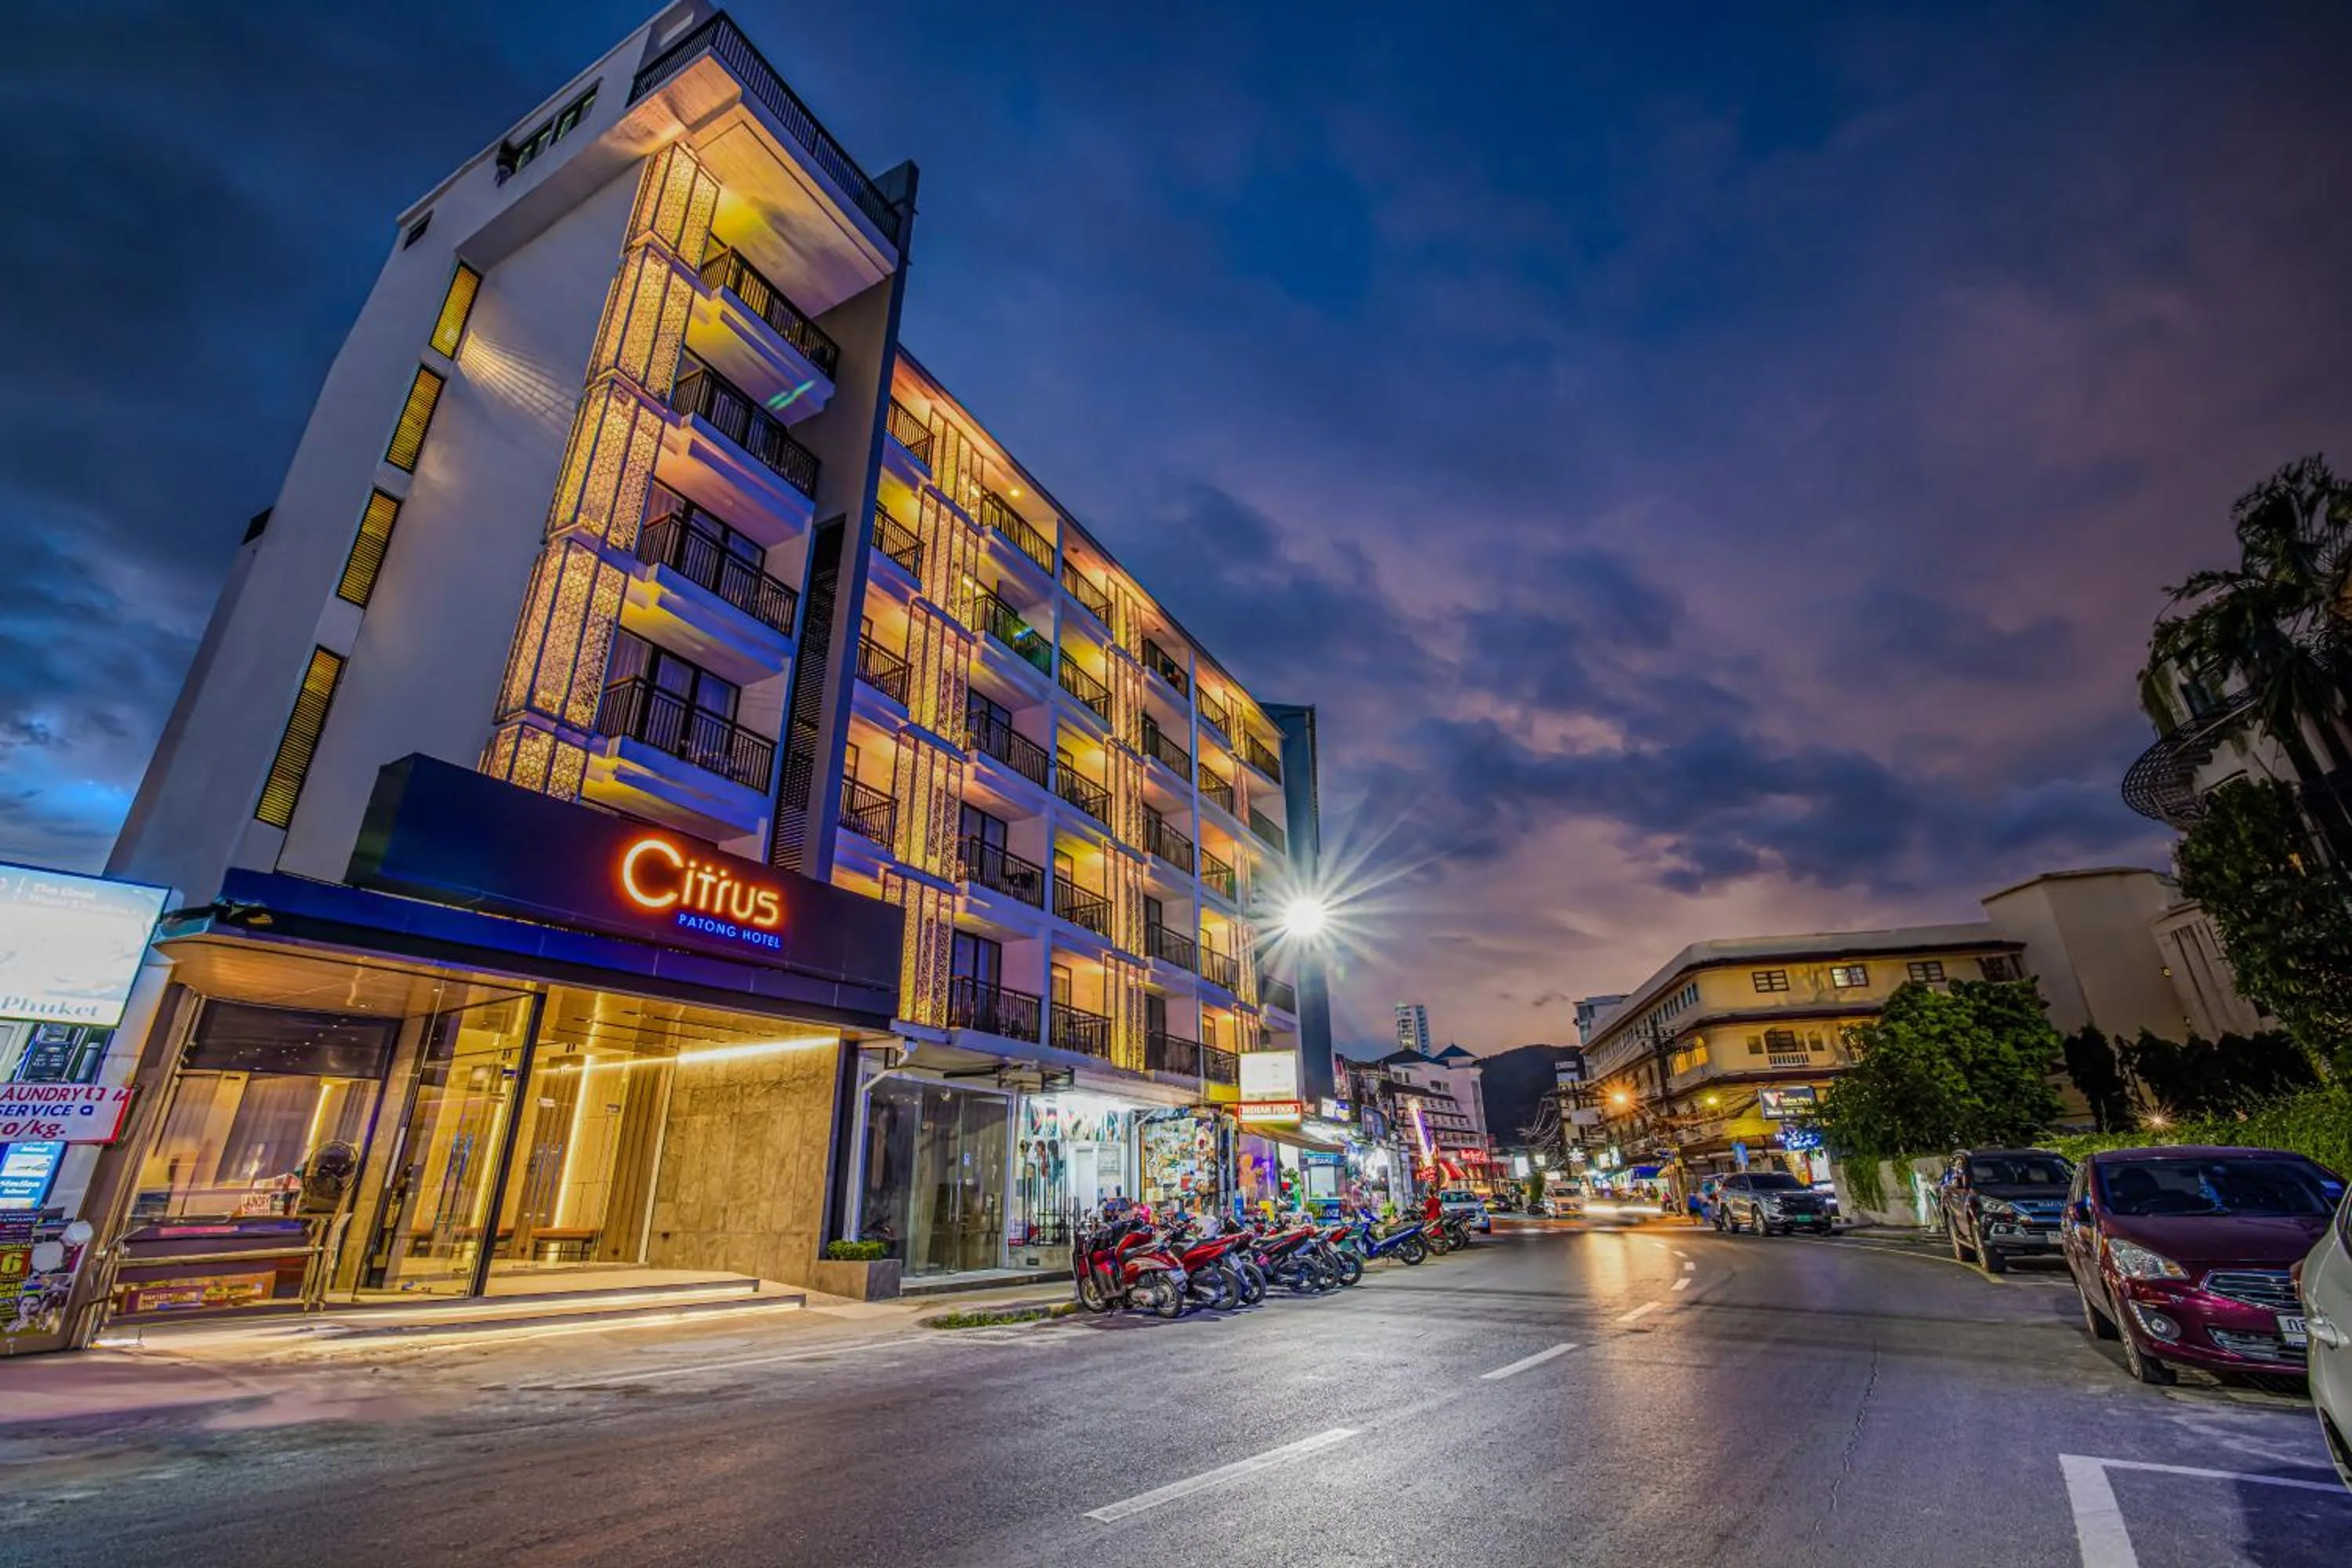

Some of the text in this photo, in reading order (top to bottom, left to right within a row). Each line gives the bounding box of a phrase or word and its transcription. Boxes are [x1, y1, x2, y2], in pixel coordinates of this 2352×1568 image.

[622, 838, 779, 927] Citrus
[678, 913, 781, 949] PATONG HOTEL
[2, 996, 98, 1017] Phuket
[0, 1119, 66, 1139] 0/kg.
